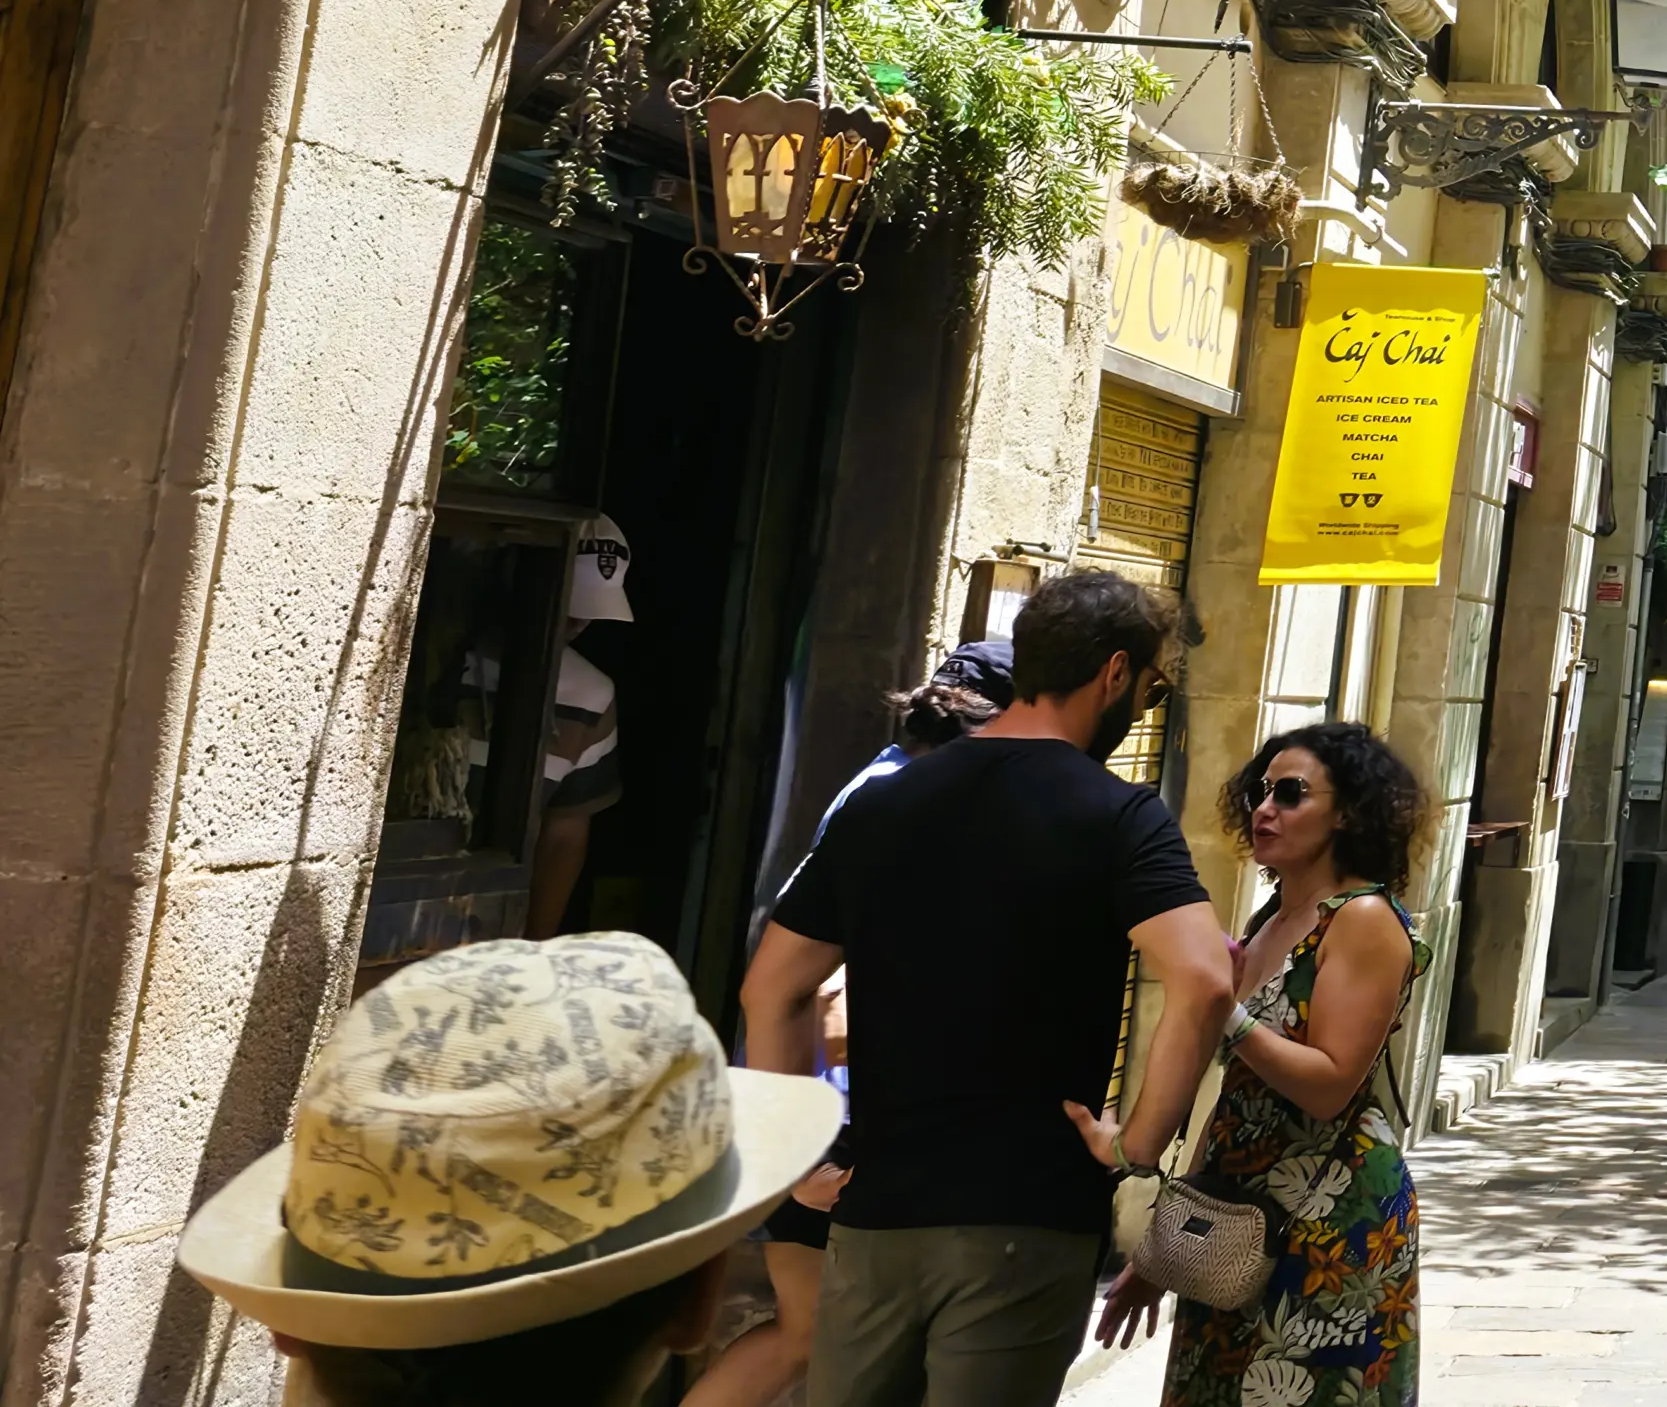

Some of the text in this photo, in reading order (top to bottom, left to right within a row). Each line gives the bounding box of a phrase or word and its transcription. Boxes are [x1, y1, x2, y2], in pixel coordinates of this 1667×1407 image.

[1383, 329, 1452, 366] Chai
[1316, 395, 1439, 406] ARTISAN ICED TEA
[1336, 414, 1412, 424] ICE CREAM
[1342, 433, 1398, 442] MATCHA
[1351, 452, 1384, 461] CHAI
[1352, 472, 1377, 480] TEA
